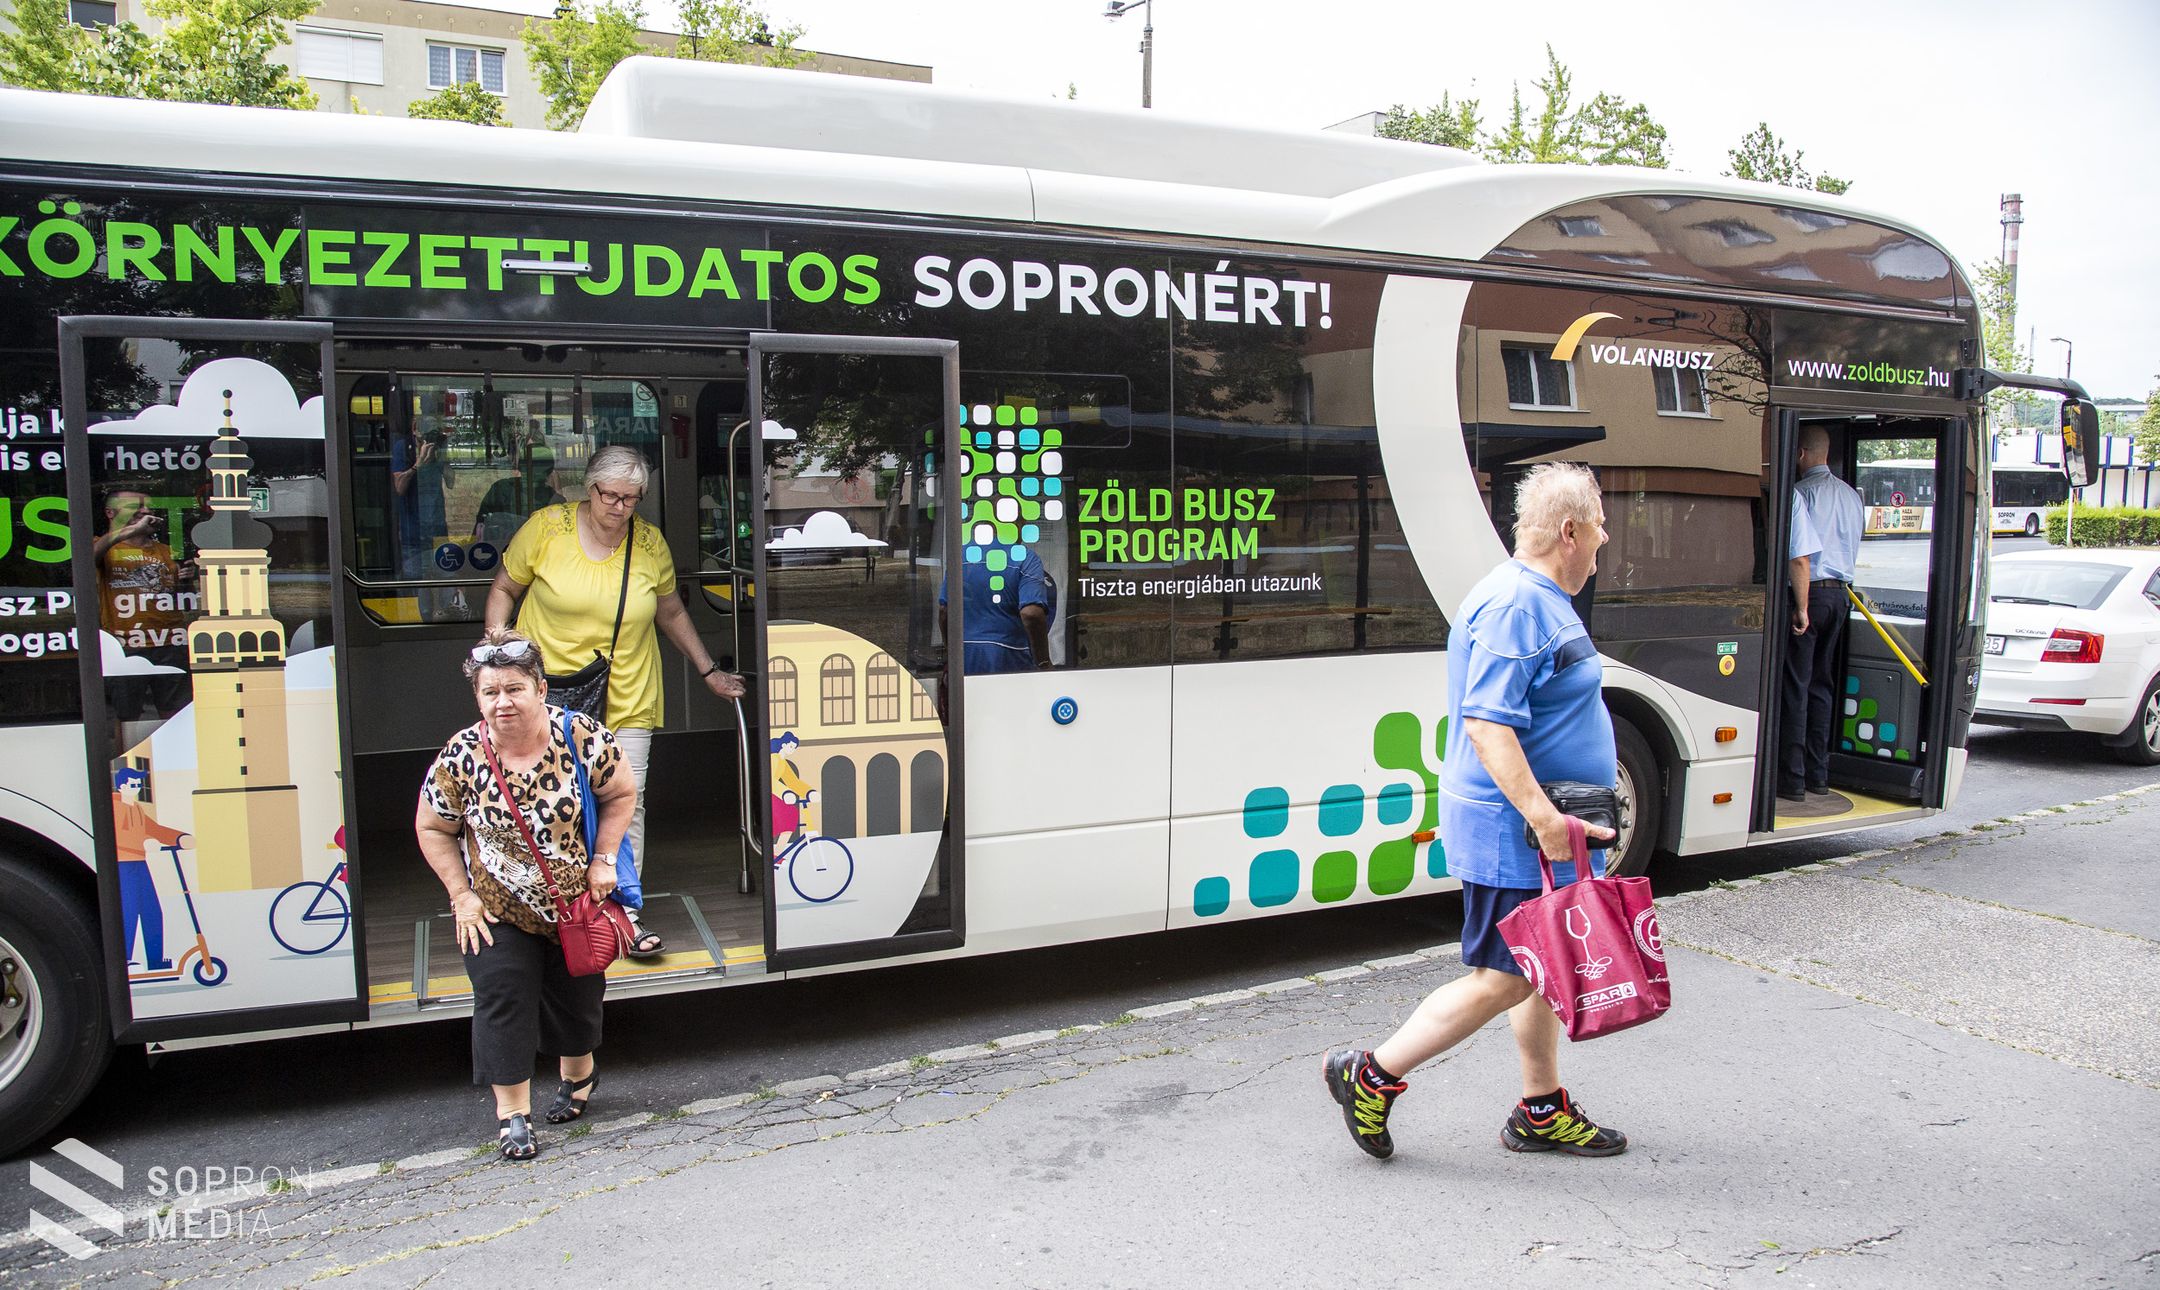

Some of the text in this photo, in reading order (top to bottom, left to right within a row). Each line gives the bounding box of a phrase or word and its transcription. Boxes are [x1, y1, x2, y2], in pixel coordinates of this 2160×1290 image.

[914, 255, 1333, 330] SOPRONÉRT!
[1787, 358, 1950, 388] www.zoldbusz.hu
[1078, 479, 1276, 522] ZÖLD BUSZ
[1080, 527, 1258, 563] PROGRAM
[1078, 572, 1322, 599] Tiszta energiában utazunk
[1582, 988, 1621, 1007] SPAR
